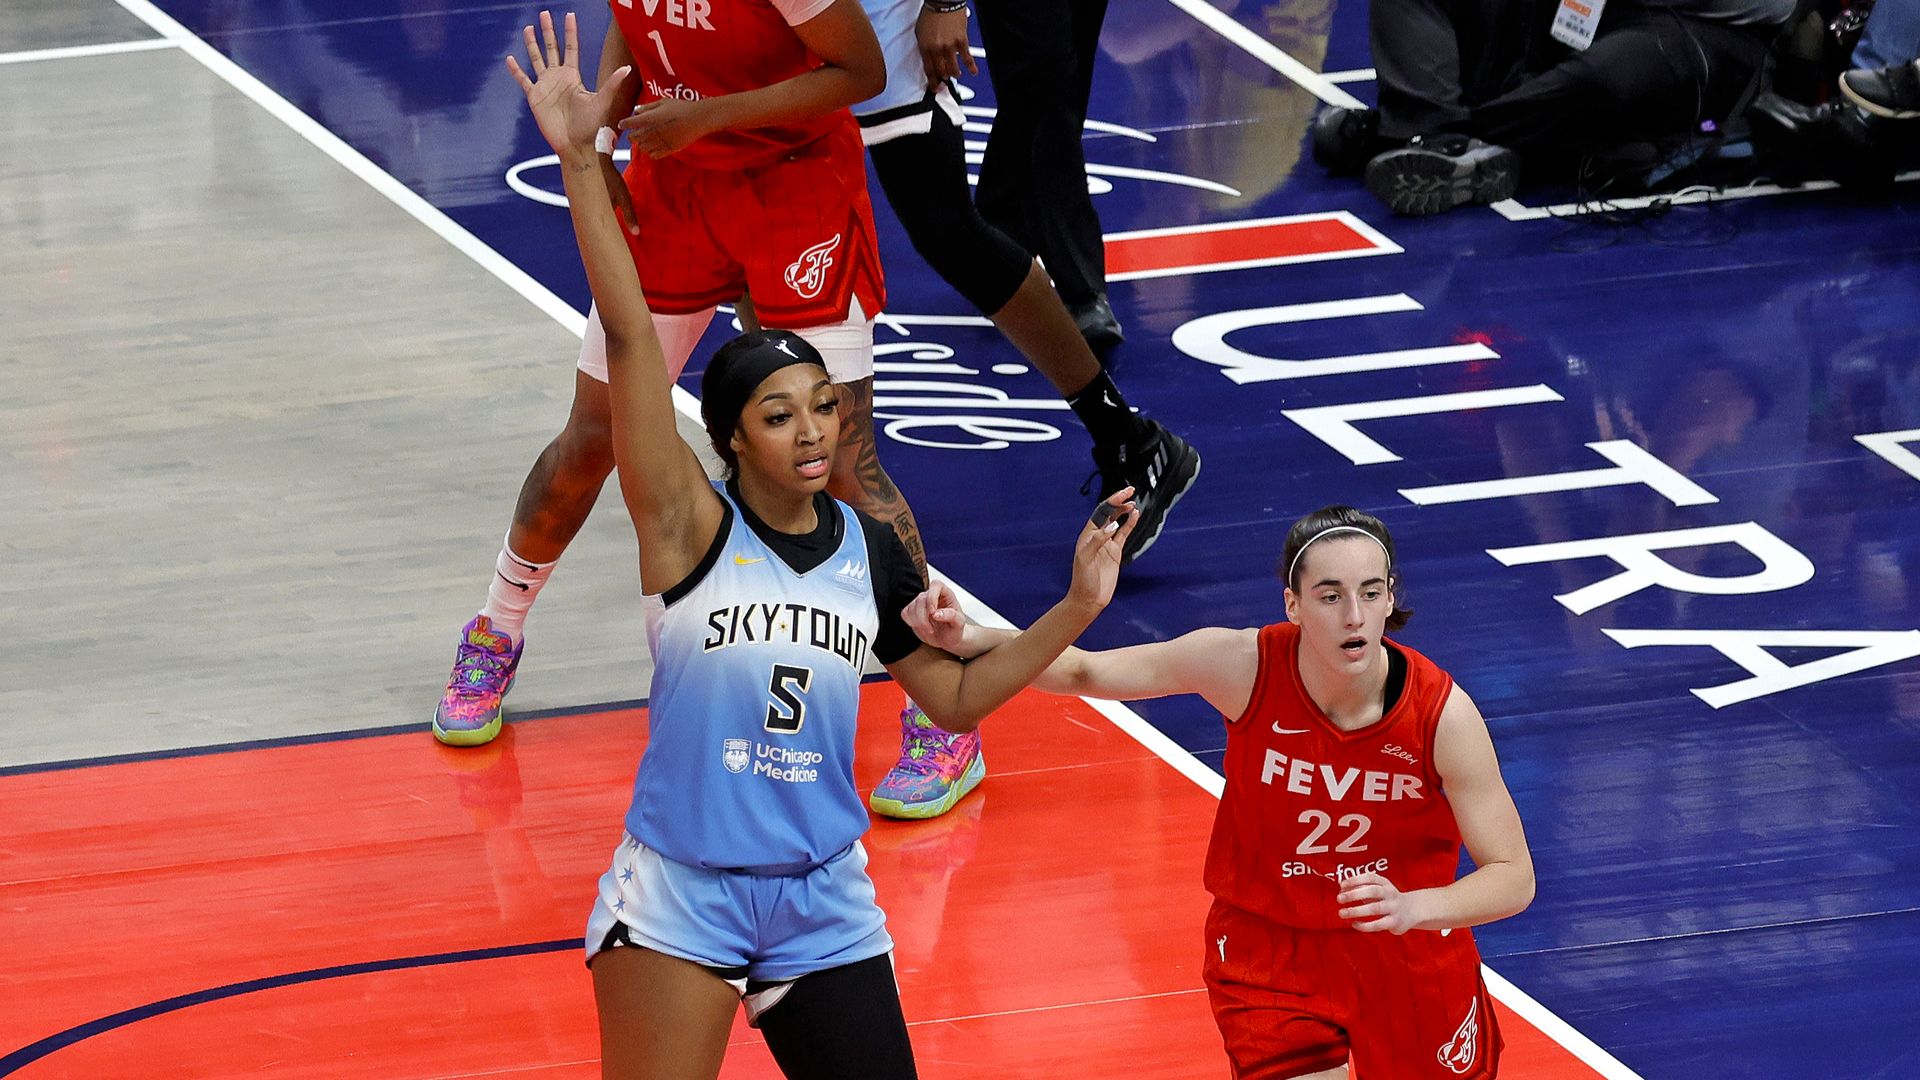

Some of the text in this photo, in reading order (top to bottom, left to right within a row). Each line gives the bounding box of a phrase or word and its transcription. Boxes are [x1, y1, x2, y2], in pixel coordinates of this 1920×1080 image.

[618, 0, 716, 31] VER
[647, 30, 676, 77] 1
[1171, 293, 1920, 710] ULTRA
[703, 603, 869, 679] SKYTOWN
[764, 662, 813, 735] 5
[753, 760, 818, 783] Medicine
[755, 742, 824, 766] UChicago
[1260, 748, 1424, 801] FEVER
[1295, 809, 1372, 855] 22
[1282, 858, 1389, 882] saforce
